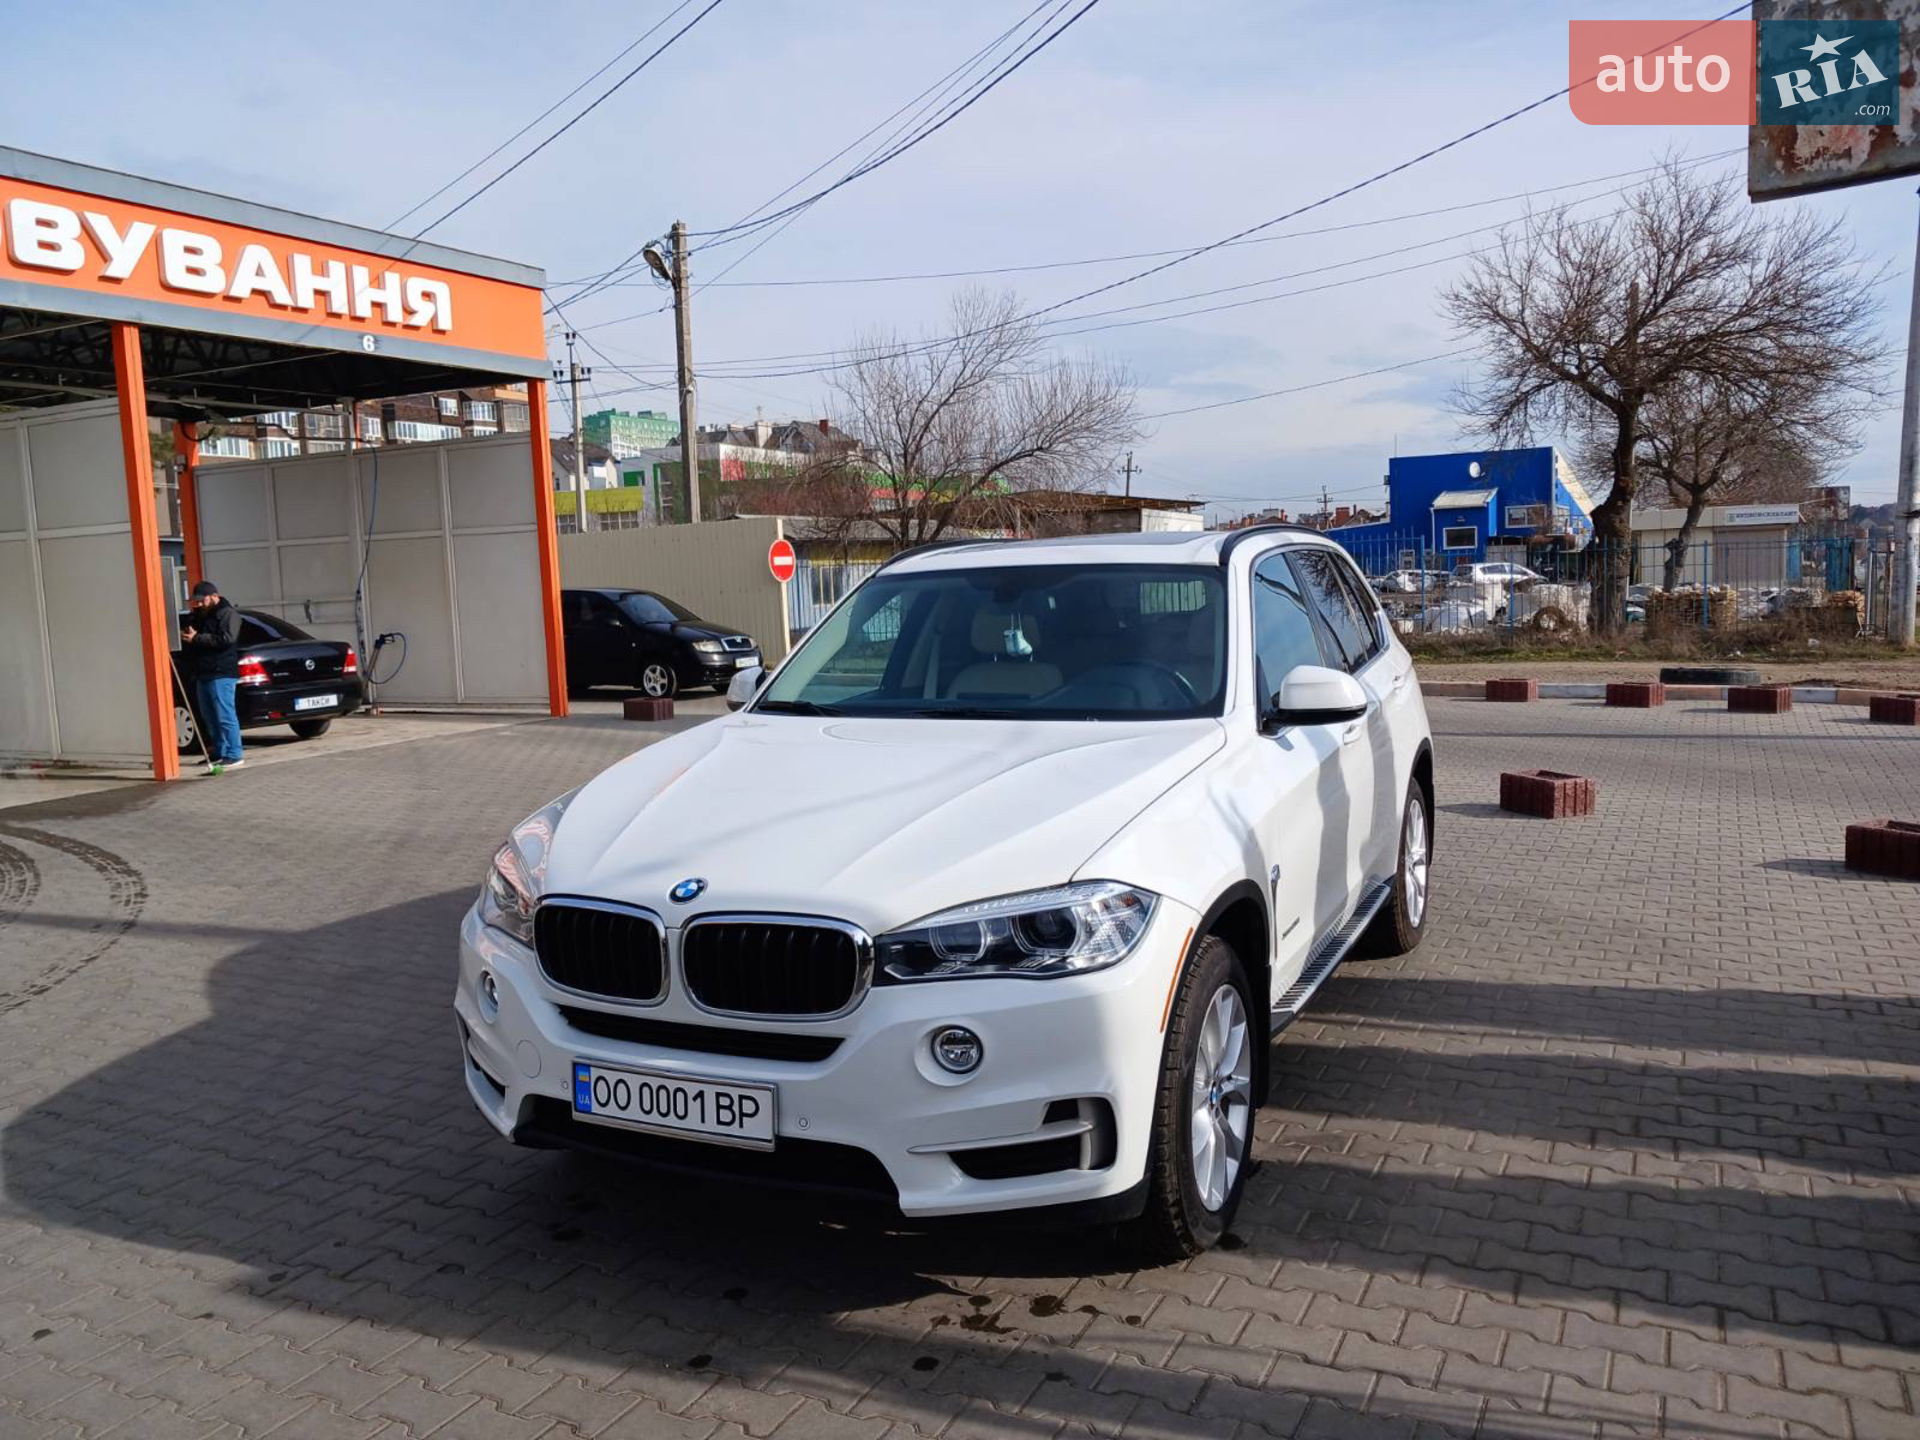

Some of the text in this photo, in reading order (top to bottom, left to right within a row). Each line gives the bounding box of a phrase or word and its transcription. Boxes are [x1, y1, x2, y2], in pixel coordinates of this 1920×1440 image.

[0, 198, 452, 332] ВУВАННЯ
[362, 334, 376, 352] 6
[639, 1082, 706, 1124] 0001
[715, 1091, 761, 1129] BP
